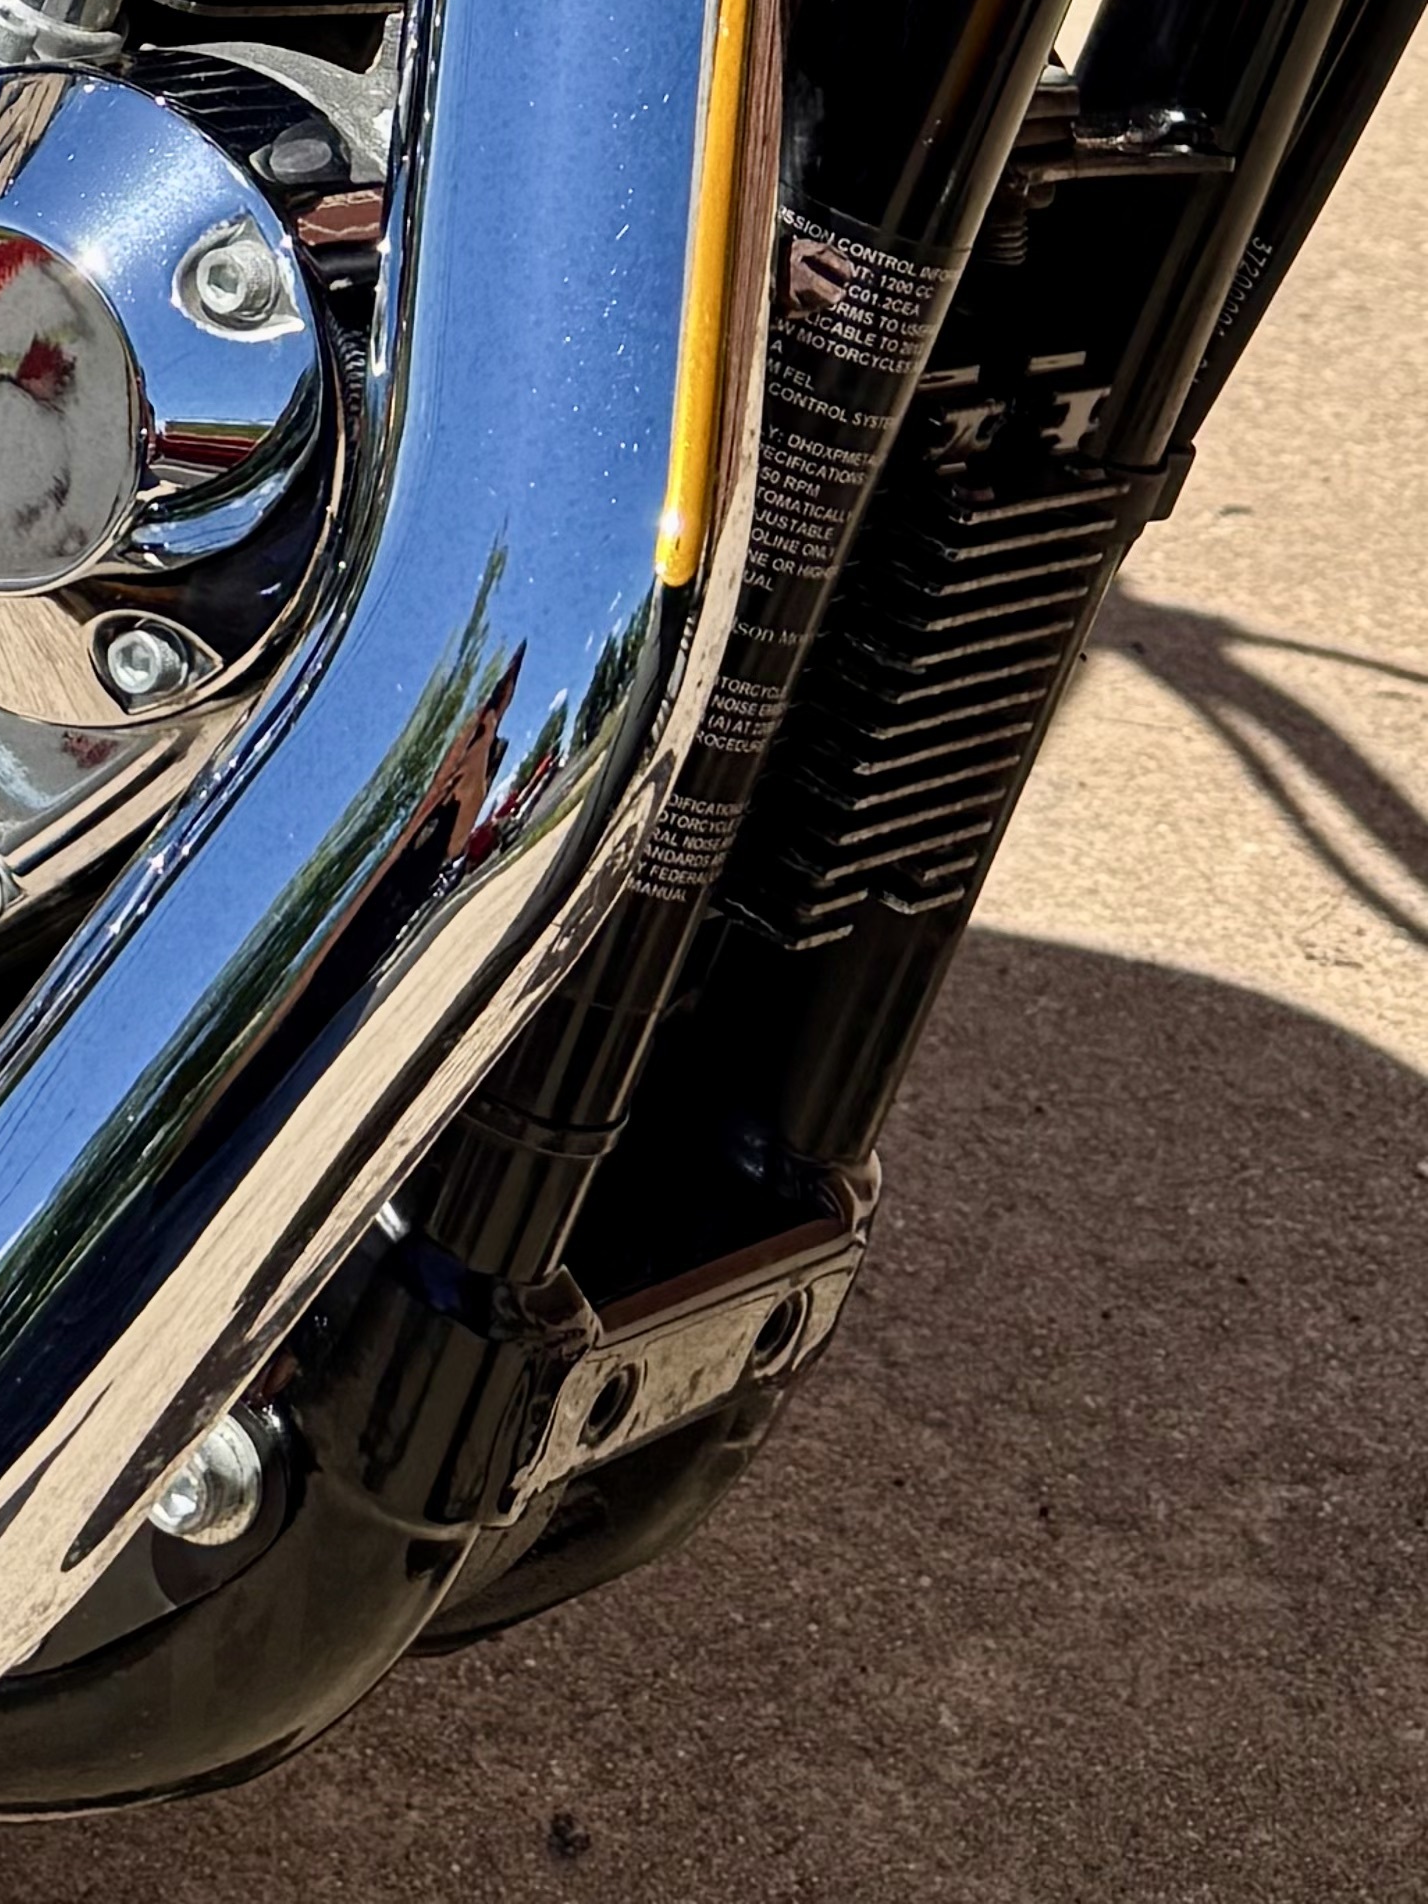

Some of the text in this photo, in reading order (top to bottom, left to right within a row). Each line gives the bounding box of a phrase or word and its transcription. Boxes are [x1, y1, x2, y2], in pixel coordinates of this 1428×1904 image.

[837, 237, 917, 275] CONTROL
[879, 275, 913, 294] 1200
[1216, 236, 1273, 337] 3720000
[843, 282, 920, 316] C01.2CEA
[880, 315, 899, 332] TO
[880, 335, 899, 352] TO
[783, 366, 815, 391] FEL
[767, 383, 848, 423] CONTROL
[783, 474, 821, 498] RPM
[754, 507, 834, 541] JUSTABLE
[772, 558, 795, 576] OR
[710, 694, 758, 716] NOISE
